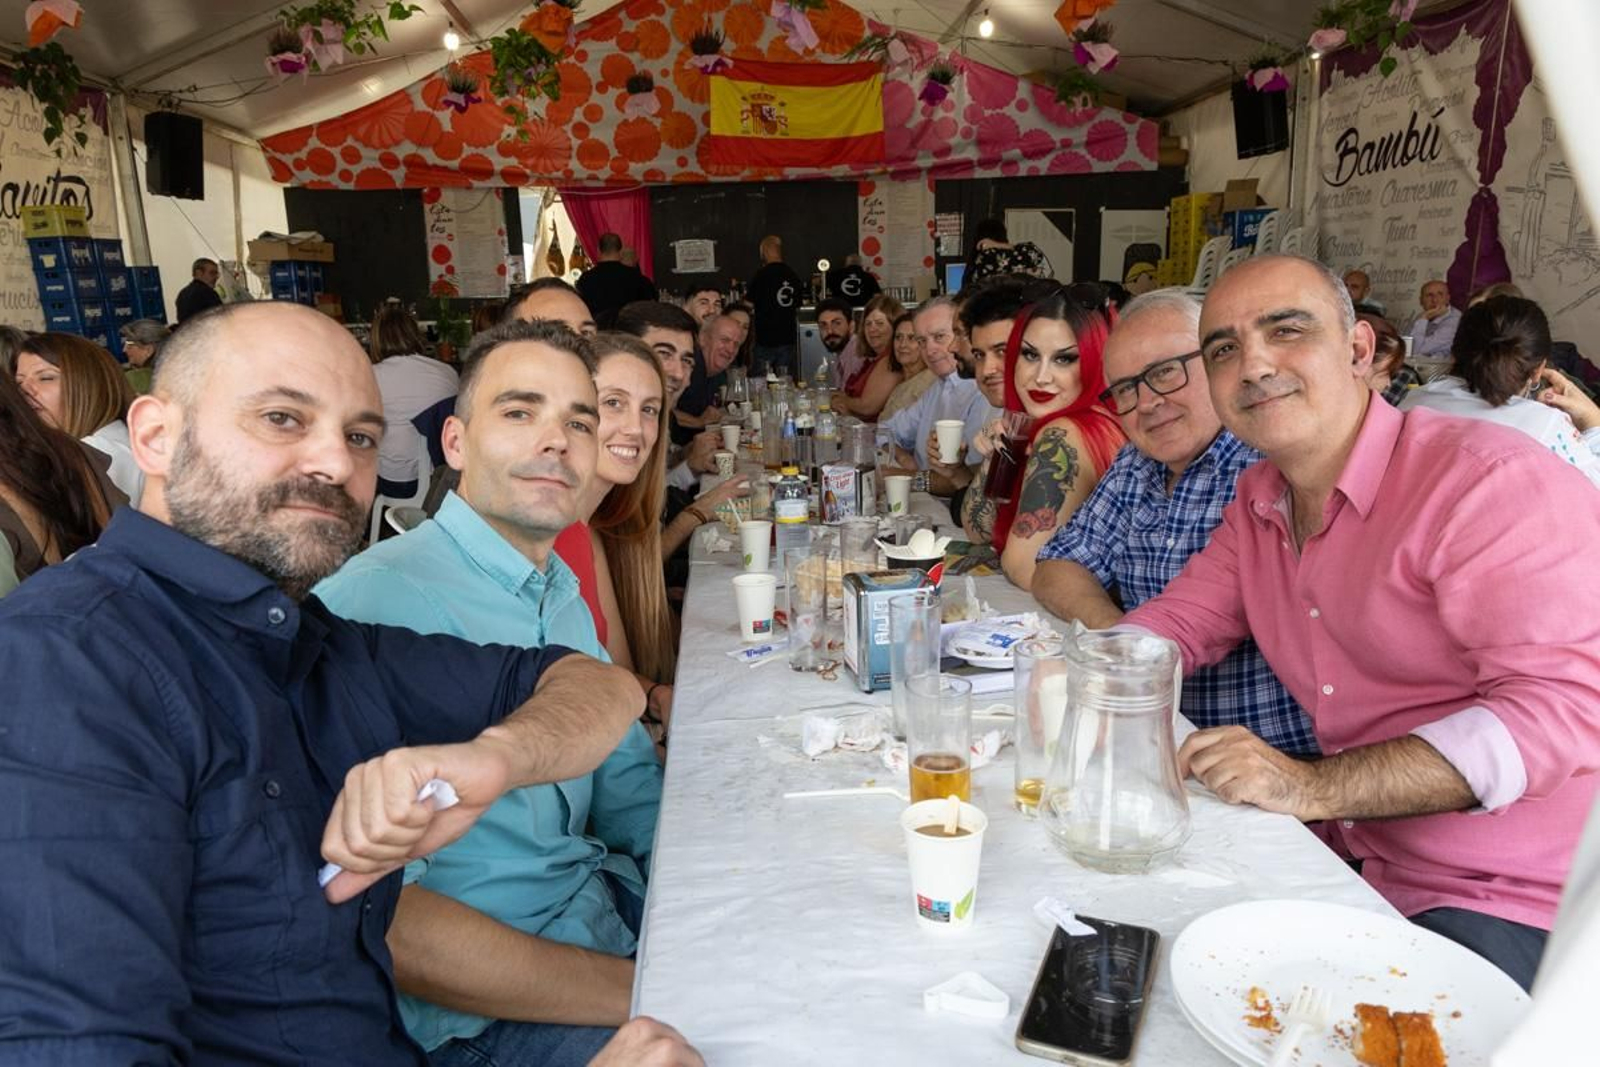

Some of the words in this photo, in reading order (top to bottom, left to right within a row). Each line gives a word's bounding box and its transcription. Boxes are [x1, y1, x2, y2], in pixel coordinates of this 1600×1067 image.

[1322, 107, 1445, 188] Bambú
[1380, 179, 1459, 208] Cuaresma
[1382, 215, 1418, 244] Tuna
